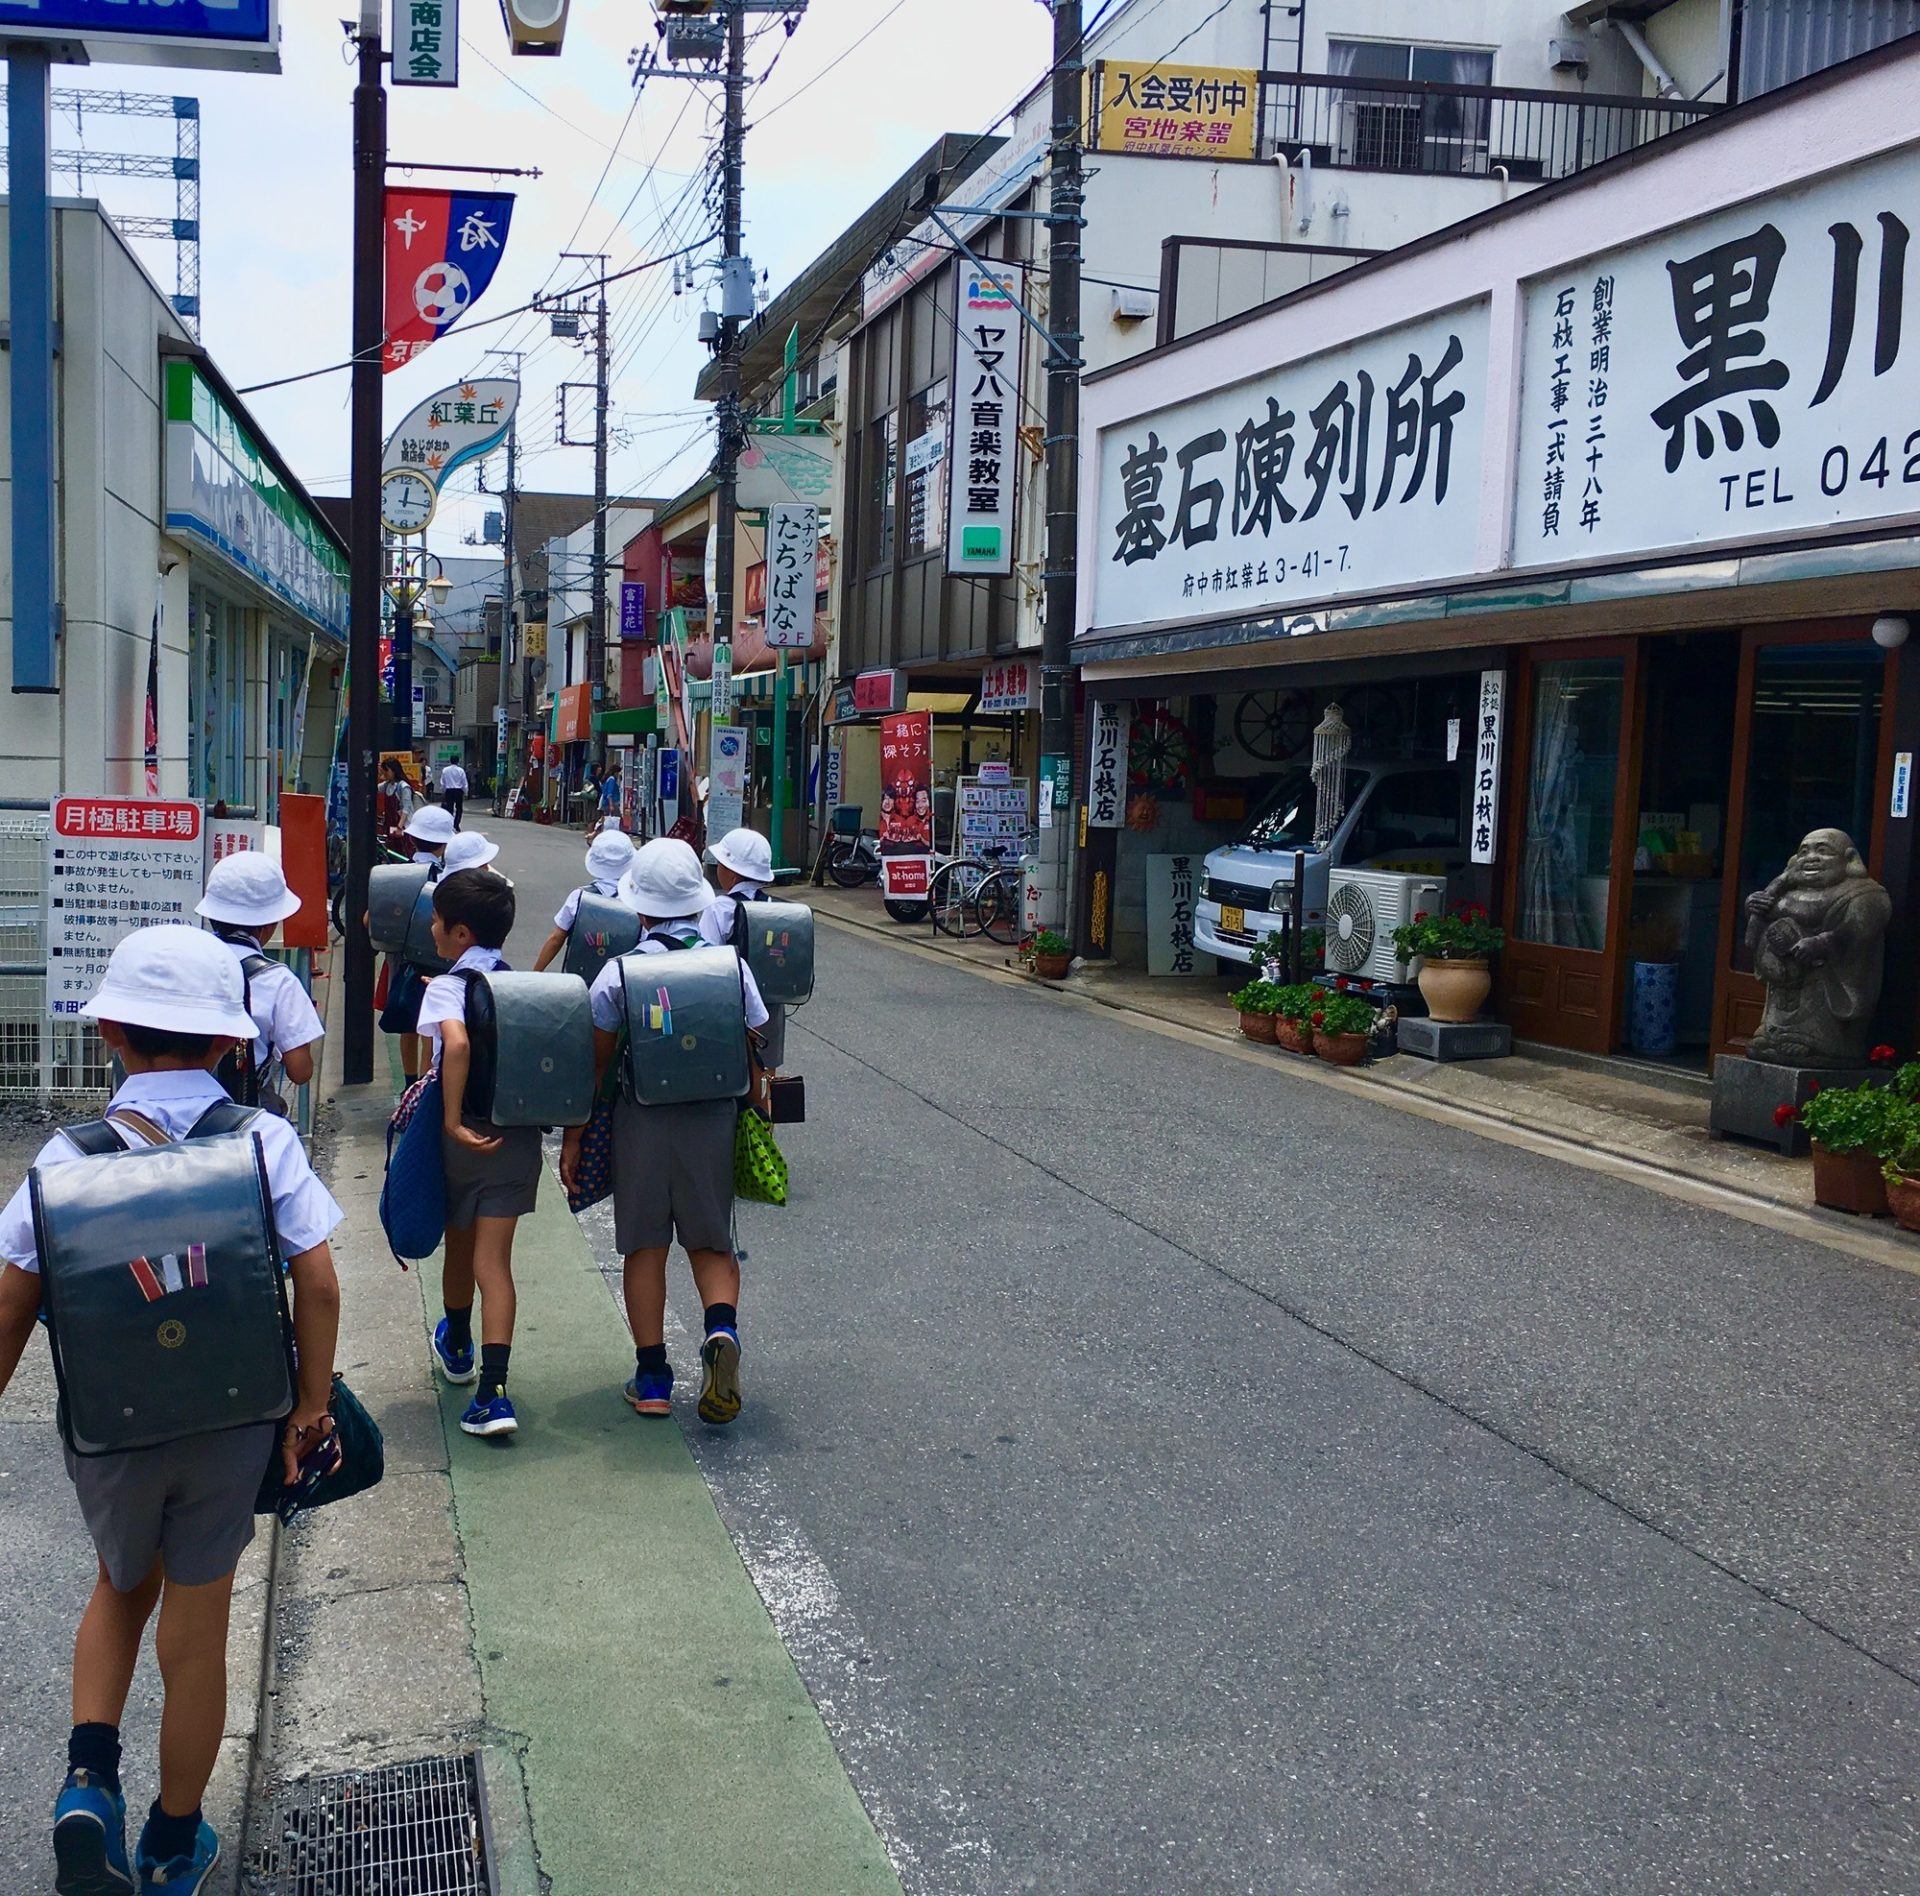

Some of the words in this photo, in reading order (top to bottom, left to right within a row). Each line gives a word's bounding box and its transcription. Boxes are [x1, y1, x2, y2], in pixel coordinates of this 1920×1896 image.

[409, 1, 442, 78] 商店会
[1113, 73, 1246, 116] 入会受付中
[1123, 117, 1233, 144] 宮地楽器
[431, 402, 498, 425] 紅葉丘
[1579, 275, 1615, 534] 創業明治三十八年
[967, 324, 1006, 513] ヤマハ音楽教室
[401, 439, 450, 451] もみじがおか
[401, 450, 425, 462] 商店会
[1112, 334, 1467, 567] 墓石陳列所
[400, 476, 412, 485] 12
[1719, 467, 1794, 511] TEL
[400, 519, 408, 528] 6
[802, 508, 815, 564] スナック
[966, 546, 996, 557] YAMAHA
[772, 513, 803, 630] たちばな
[624, 588, 636, 628] 富士花
[884, 743, 927, 758] 探そう。
[828, 752, 839, 805] POCARI
[1056, 759, 1070, 805] 通学路
[1474, 714, 1496, 852] 黒川石材店
[63, 806, 193, 834] 月極駐車場
[65, 850, 199, 864] この中で遊ばないで下さい。
[64, 865, 193, 881] 事故が発生しても一切責任
[64, 883, 134, 895] は負いません。
[64, 898, 182, 913] 当駐車場は自動車の盗難
[64, 931, 101, 943] ません。
